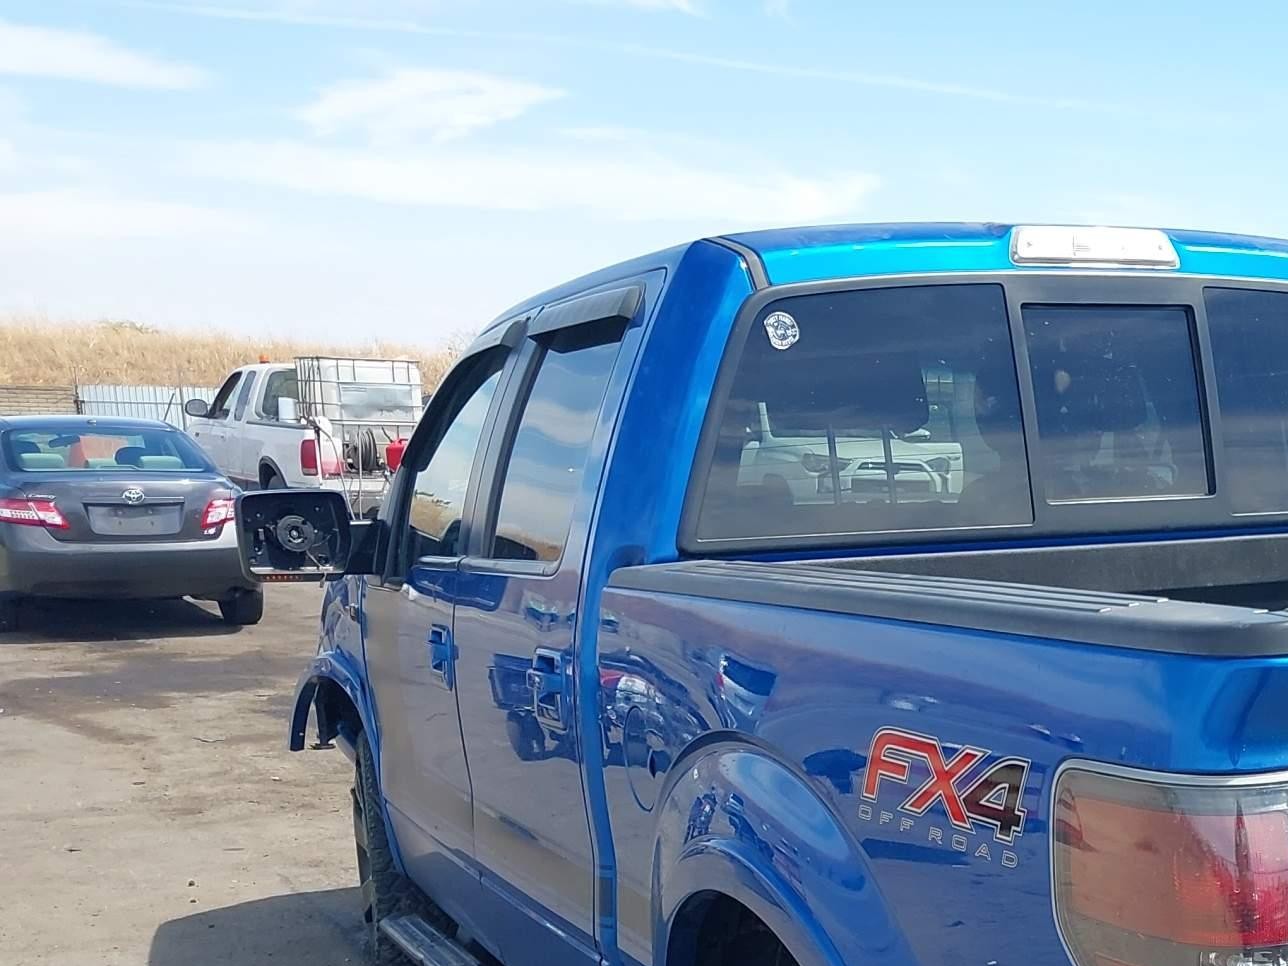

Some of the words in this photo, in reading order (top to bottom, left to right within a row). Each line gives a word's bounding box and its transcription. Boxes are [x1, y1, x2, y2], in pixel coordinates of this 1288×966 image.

[860, 725, 1032, 846] FX4
[858, 804, 914, 832] OFF
[927, 826, 1018, 869] ROAD
